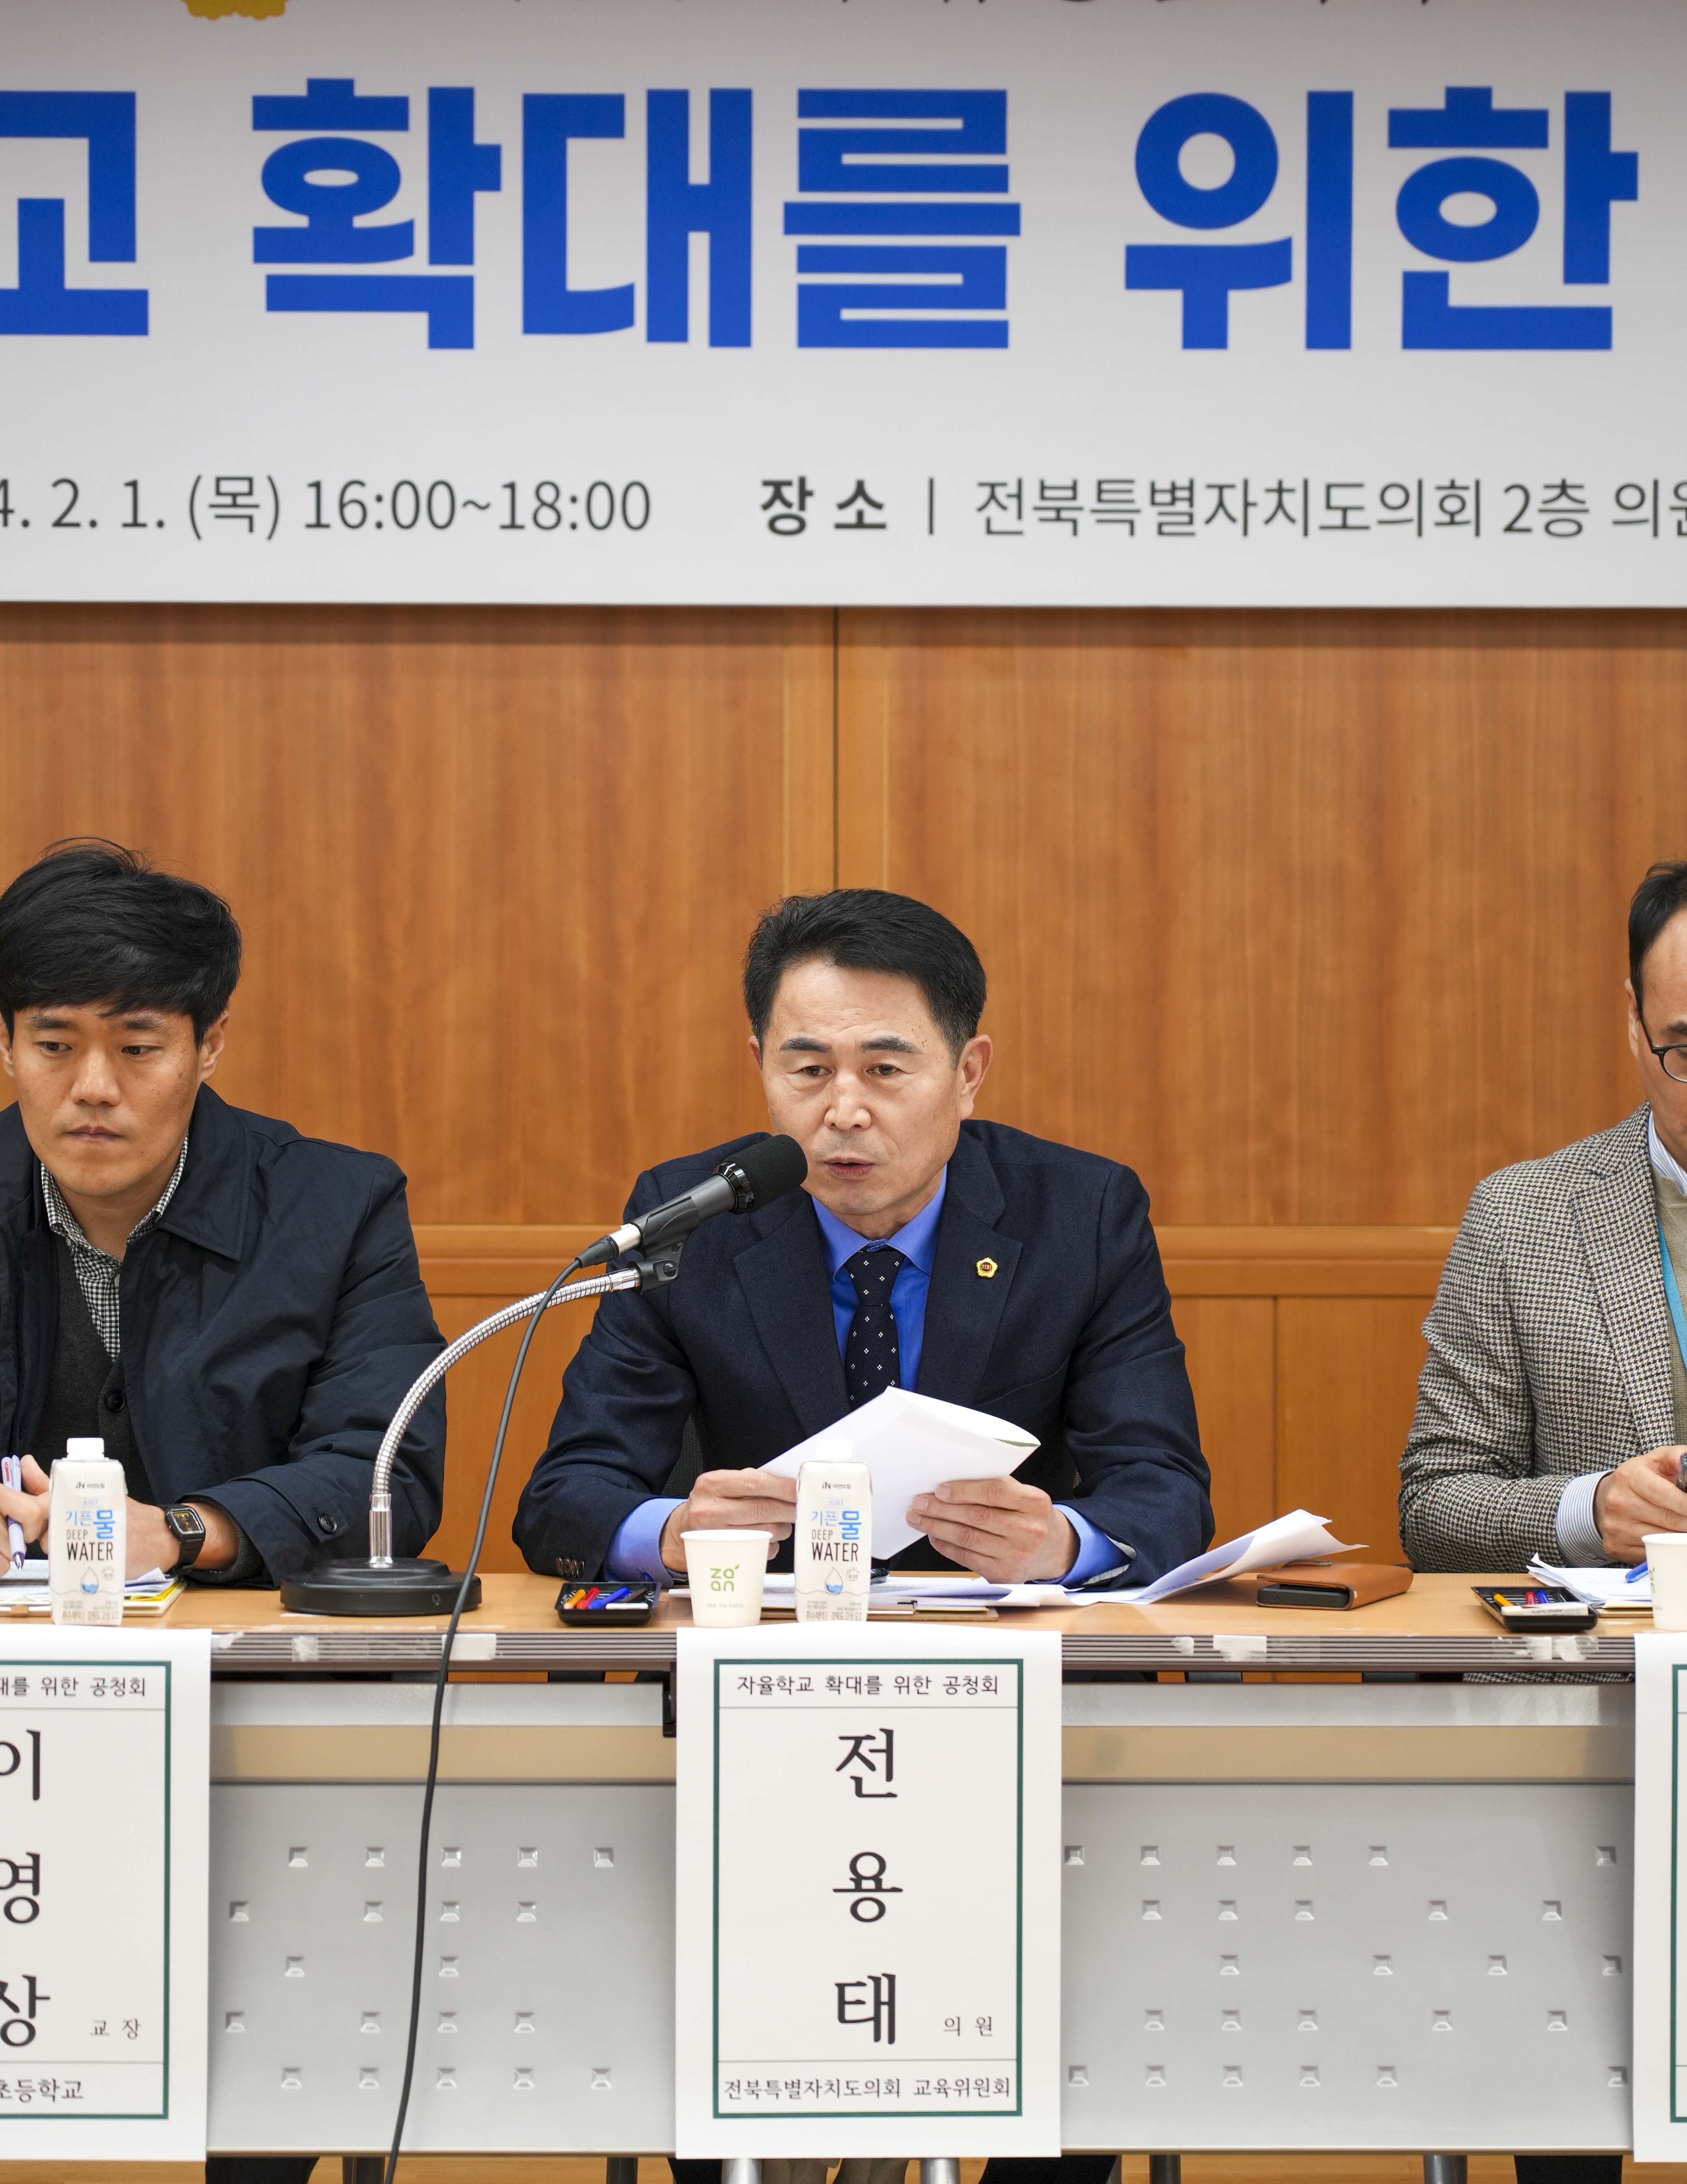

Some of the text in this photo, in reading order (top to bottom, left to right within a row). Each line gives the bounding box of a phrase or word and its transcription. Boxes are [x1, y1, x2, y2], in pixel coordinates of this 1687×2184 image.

[251, 78, 1021, 350] 확대를
[1125, 86, 1638, 351] 위한
[52, 477, 97, 528] 2.
[122, 479, 165, 528] 1.
[189, 475, 279, 540] (목)
[305, 479, 651, 531] 16:00~18:00
[977, 477, 1482, 538] 전북특별자치도의회
[1502, 478, 1590, 538] 2층
[67, 1529, 88, 1540] DEEP
[811, 1529, 833, 1541] DEEP
[67, 1542, 114, 1561] WATER
[812, 1542, 859, 1562] WATER
[41, 1677, 79, 1696] 위한
[90, 1677, 146, 1697] 공청회
[737, 1675, 998, 1695] 자율학교 확대를 위한 공청회
[724, 2077, 1010, 2100] 전북특별자치도의회 교육위원회
